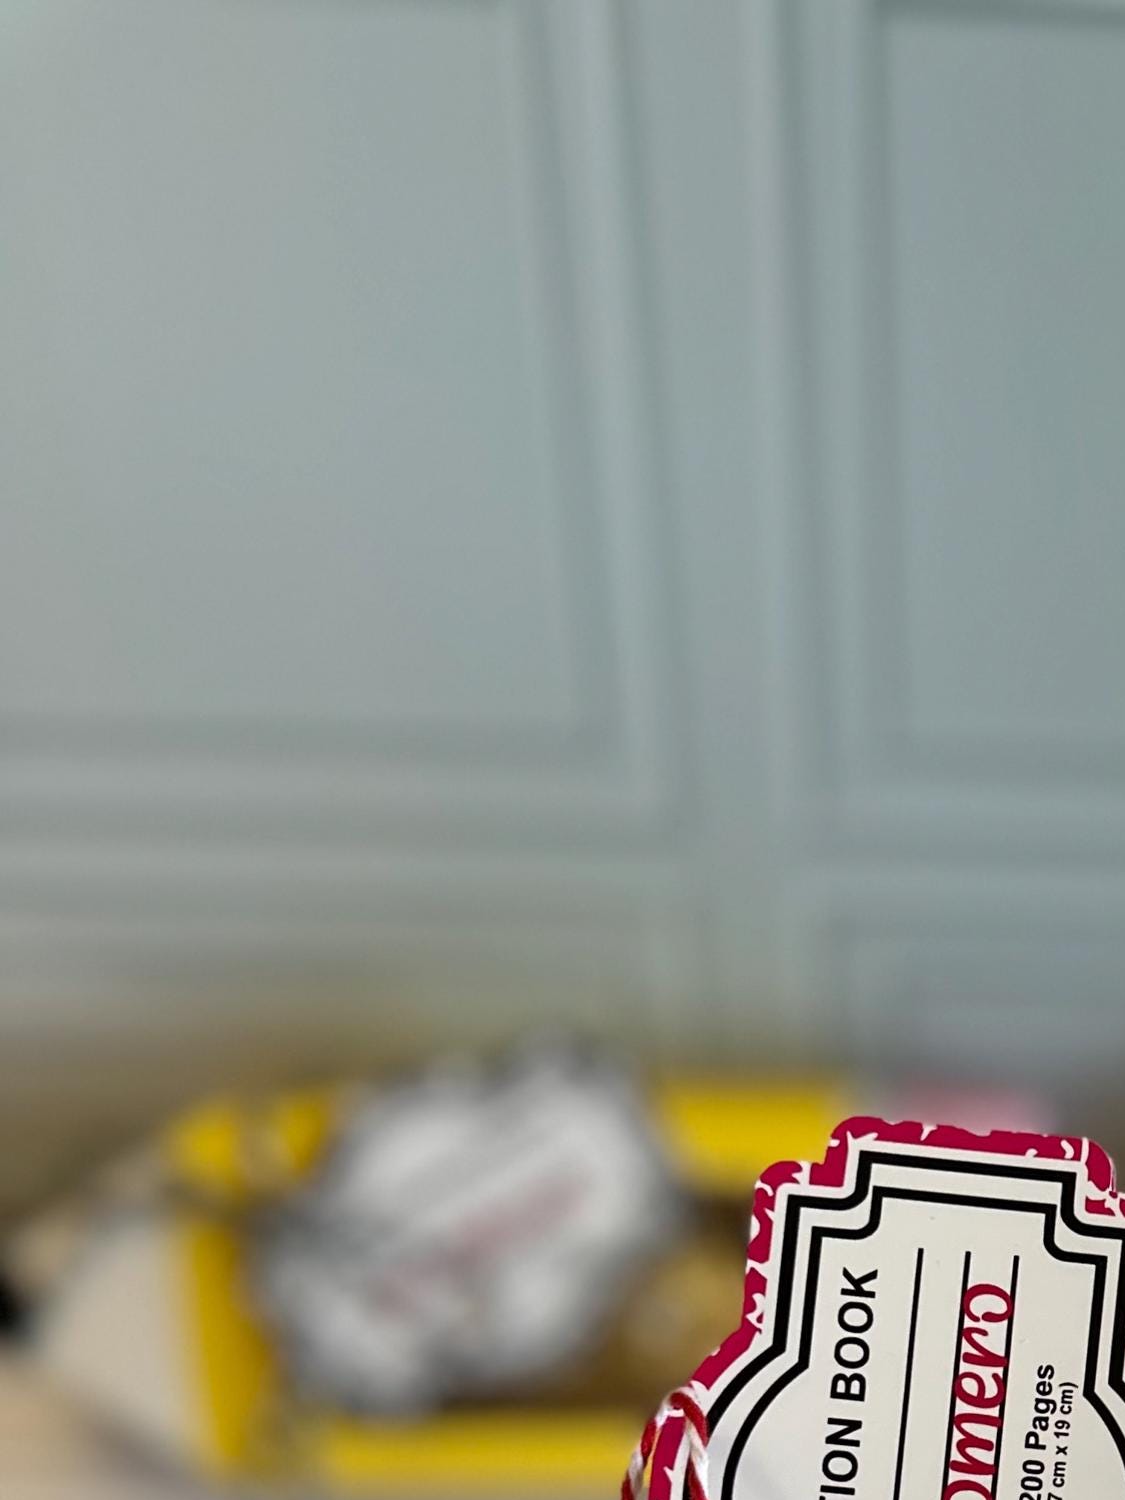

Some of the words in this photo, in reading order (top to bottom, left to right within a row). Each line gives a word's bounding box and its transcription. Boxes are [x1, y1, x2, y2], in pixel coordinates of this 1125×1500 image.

[829, 1266, 879, 1403] BOOK
[1024, 1364, 1057, 1450] Pages
[1058, 1382, 1079, 1415] cm)
[1053, 1419, 1071, 1439] 19
[1055, 1445, 1069, 1456] x
[1052, 1461, 1067, 1488] cm
